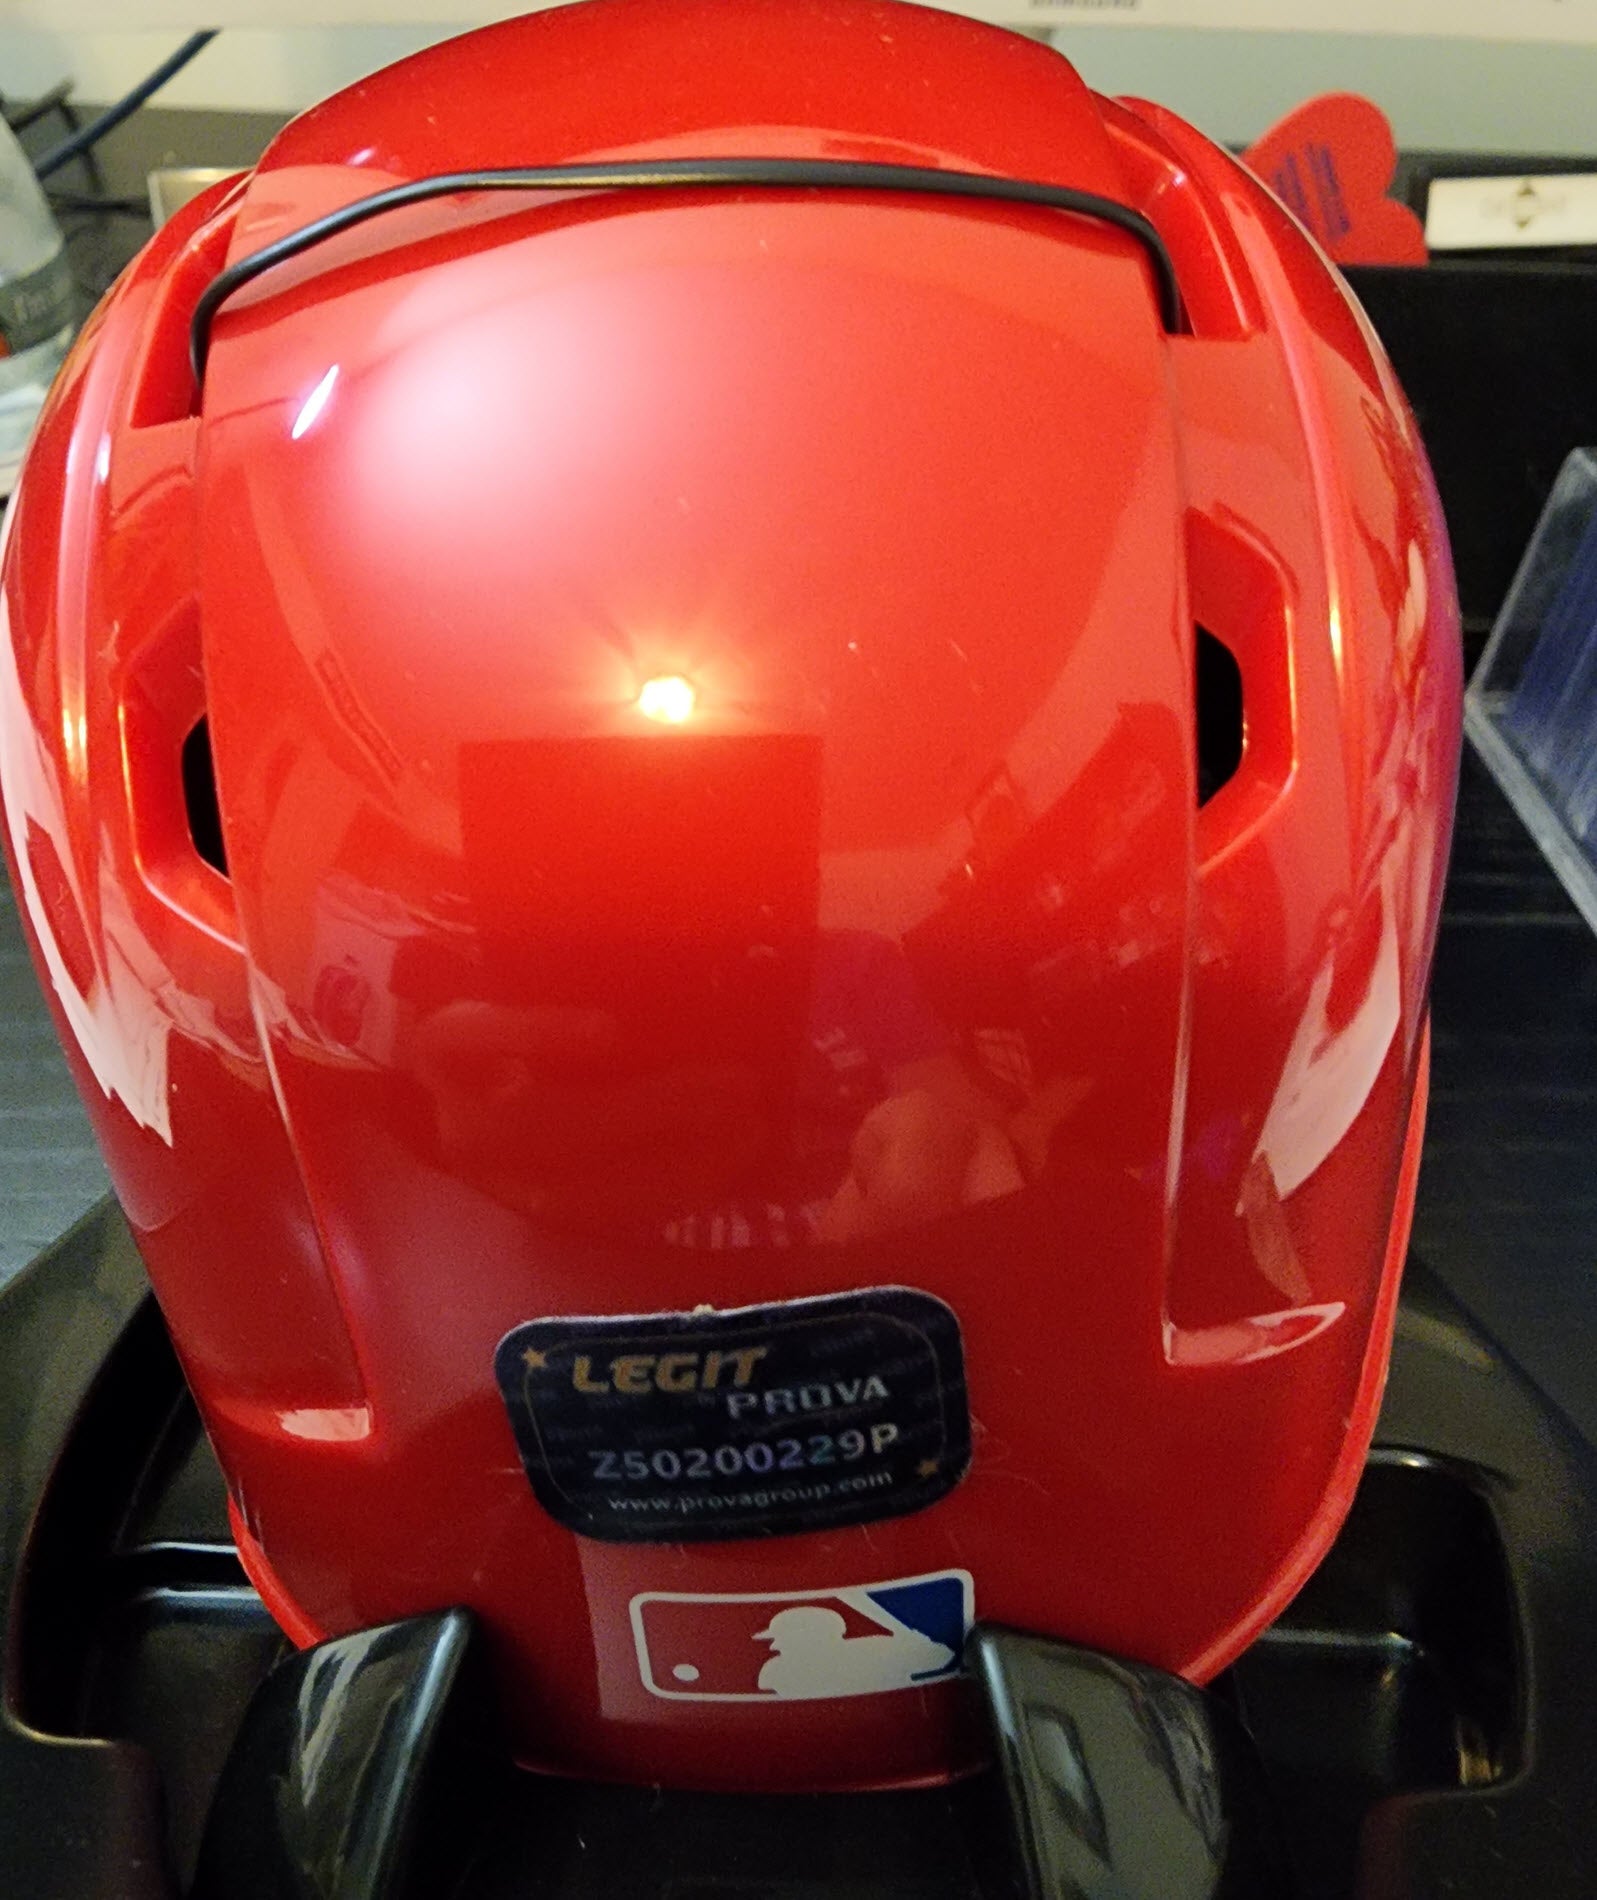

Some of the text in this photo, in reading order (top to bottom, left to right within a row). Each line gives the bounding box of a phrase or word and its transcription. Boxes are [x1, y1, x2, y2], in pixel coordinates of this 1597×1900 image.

[573, 1347, 767, 1393] LEGIT
[726, 1375, 889, 1419] PROVA
[589, 1423, 899, 1480] Z50200229P
[607, 1471, 894, 1513] www.provagroup.com
